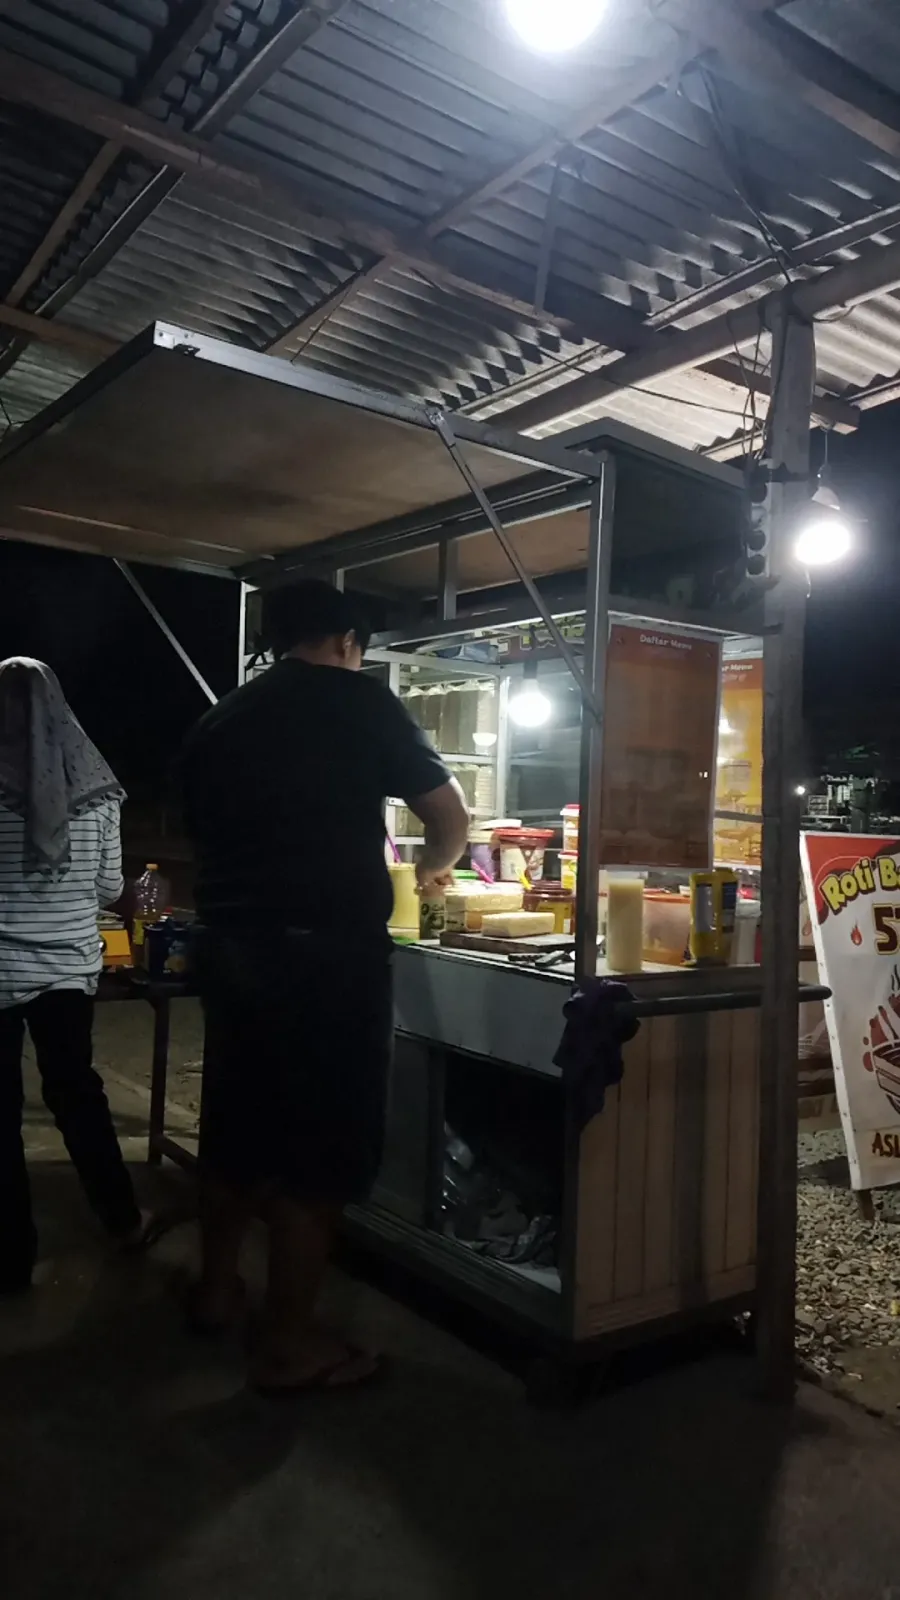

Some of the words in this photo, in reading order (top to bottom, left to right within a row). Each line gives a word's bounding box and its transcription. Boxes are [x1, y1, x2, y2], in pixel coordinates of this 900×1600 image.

[639, 633, 669, 646] Daftar
[820, 856, 875, 912] Roti
[878, 856, 900, 891] B
[874, 906, 900, 951] 5
